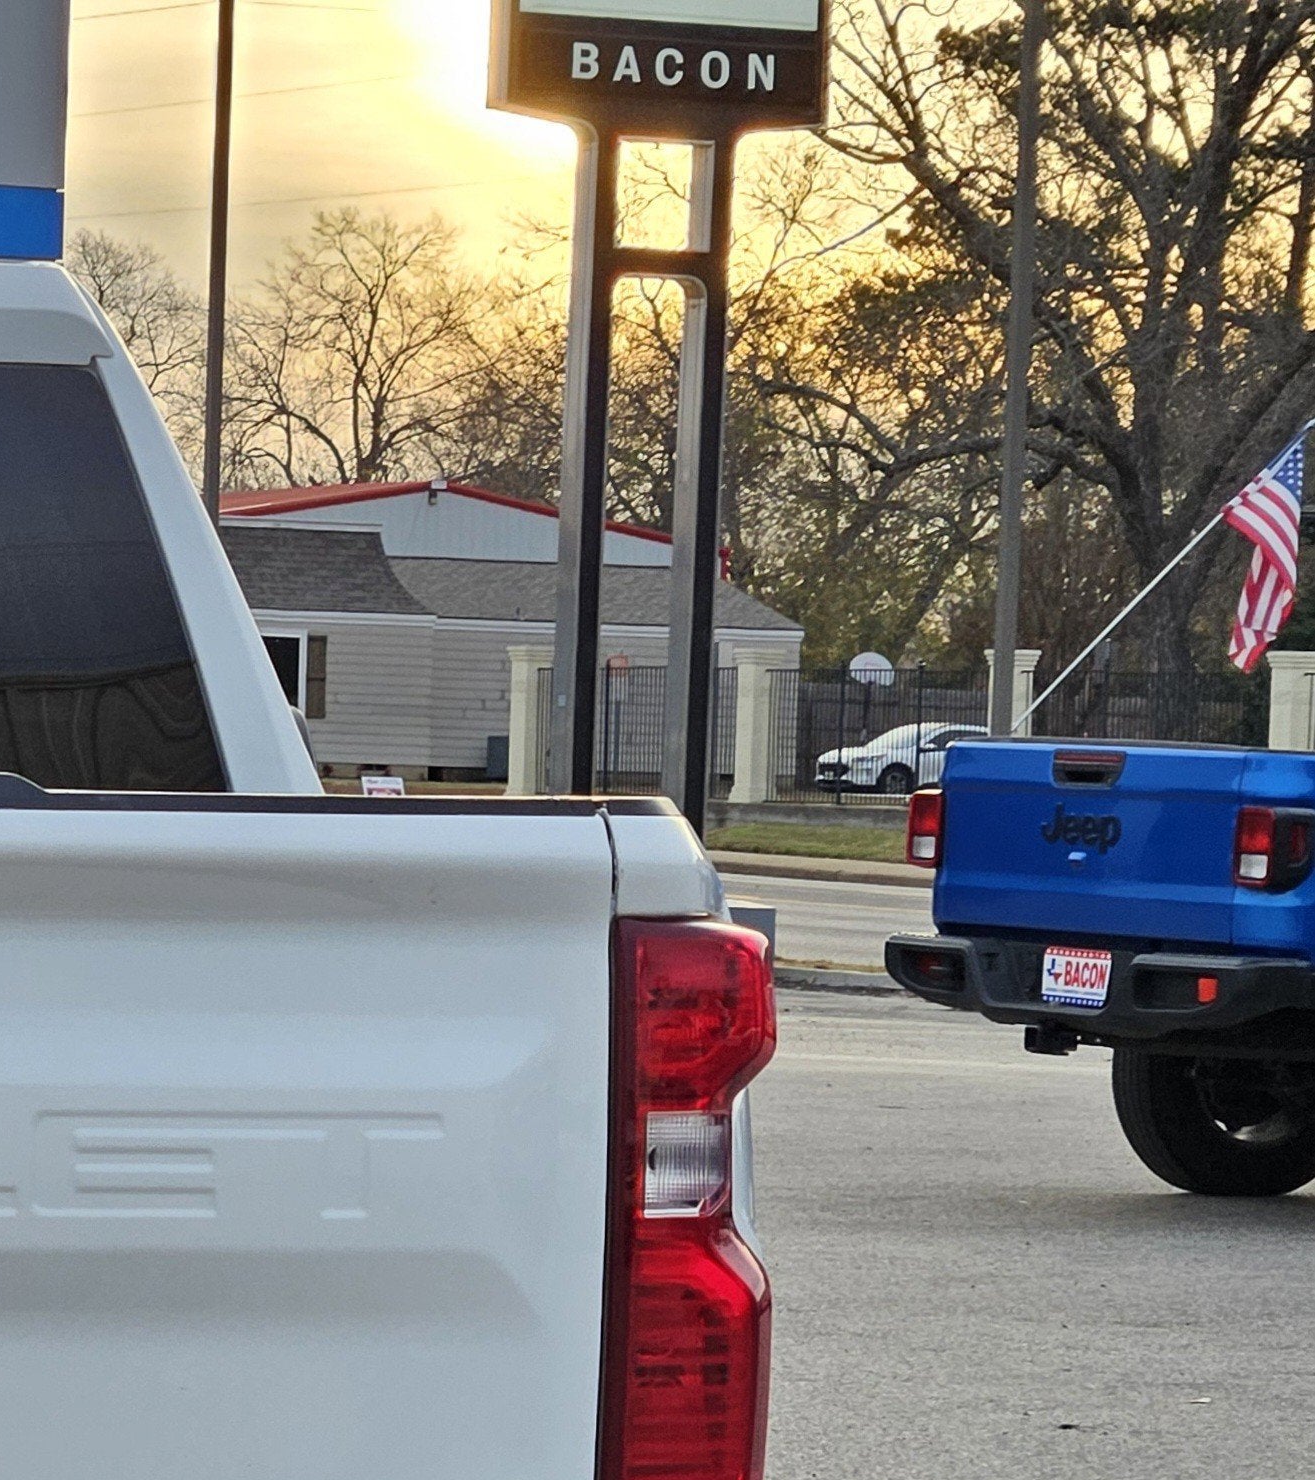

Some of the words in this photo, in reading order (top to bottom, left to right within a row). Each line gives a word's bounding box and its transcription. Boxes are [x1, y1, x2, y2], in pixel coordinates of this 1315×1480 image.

[571, 41, 775, 92] BACON
[1041, 802, 1122, 855] Jeep
[1064, 960, 1108, 990] BACON
